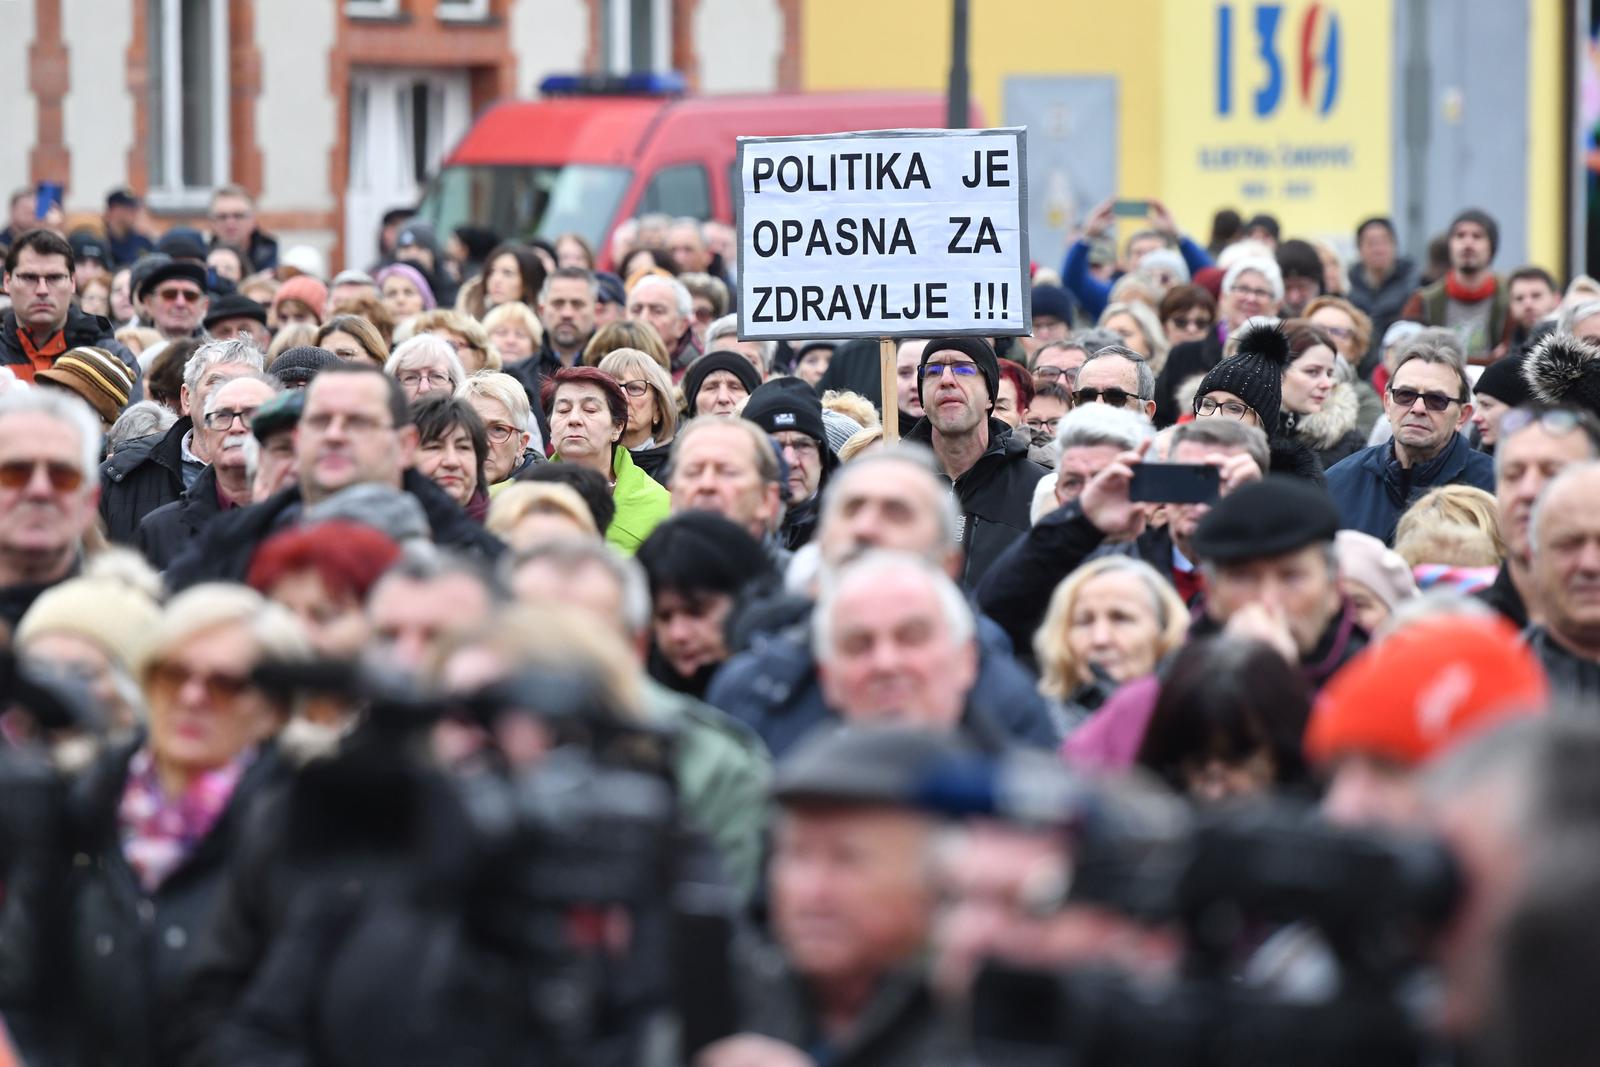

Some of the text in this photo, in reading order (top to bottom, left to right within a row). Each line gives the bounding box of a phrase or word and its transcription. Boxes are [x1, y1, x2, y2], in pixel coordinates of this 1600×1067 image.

[753, 150, 1010, 194] POLITIKA JE
[753, 216, 1002, 258] OPASNA ZA
[752, 282, 1009, 323] ZDRAVLJE !!!
